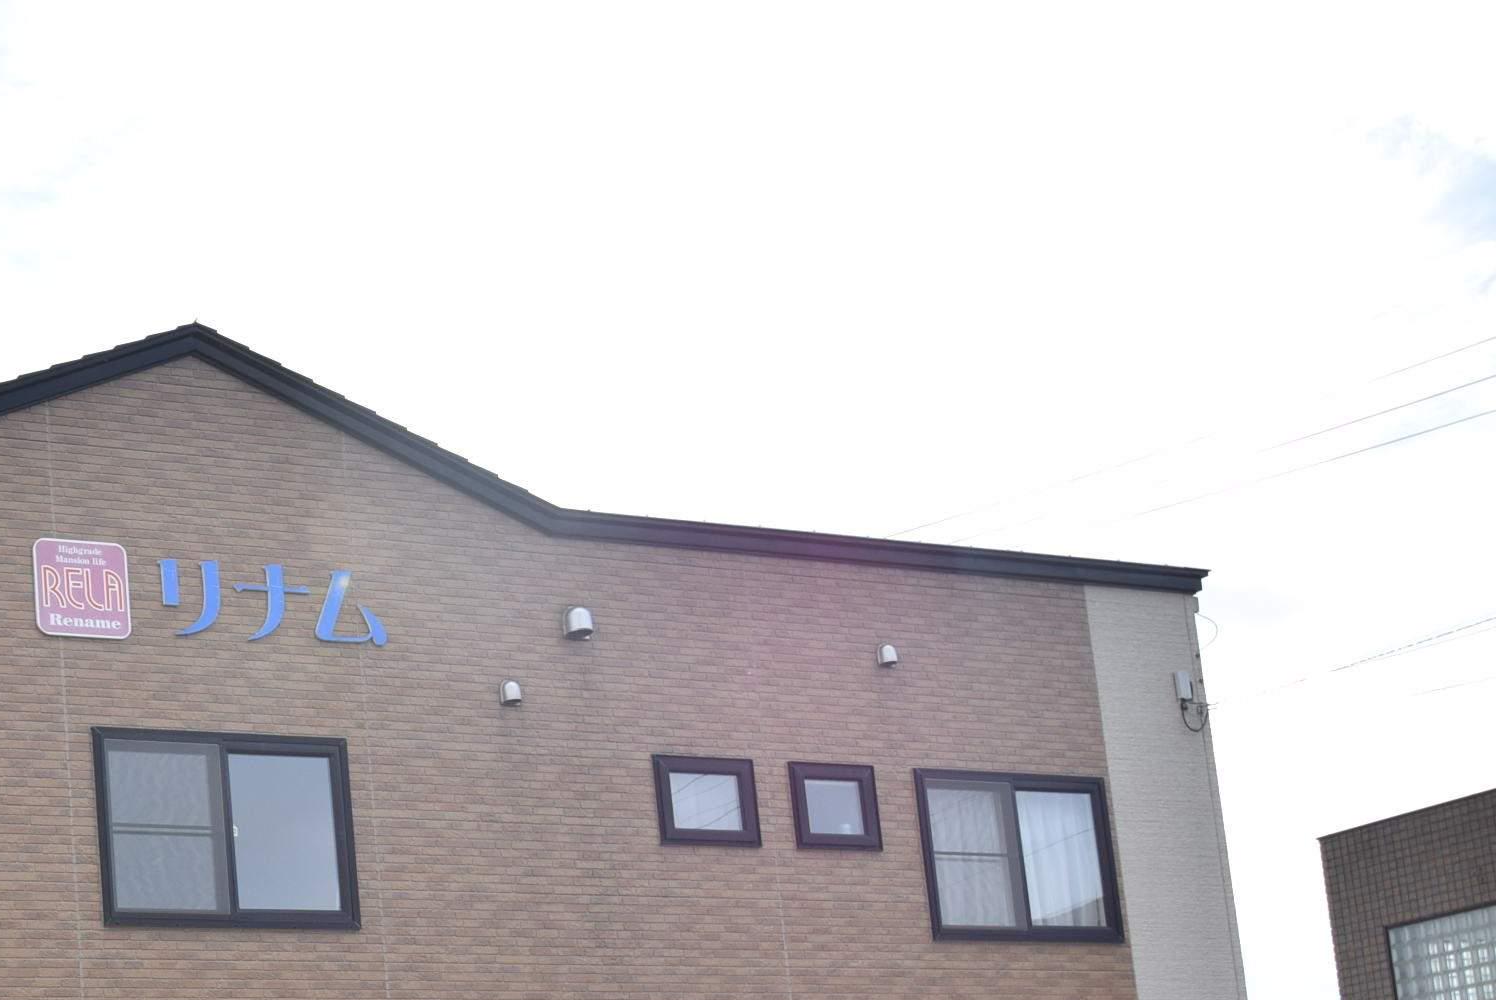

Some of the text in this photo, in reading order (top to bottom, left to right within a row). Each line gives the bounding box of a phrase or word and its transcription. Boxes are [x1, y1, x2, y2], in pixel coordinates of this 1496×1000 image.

[58, 545, 102, 556] Highgrade
[55, 555, 90, 565] Mansion
[41, 564, 125, 612] RELA
[156, 557, 389, 647] リナム
[49, 612, 121, 630] Rename
